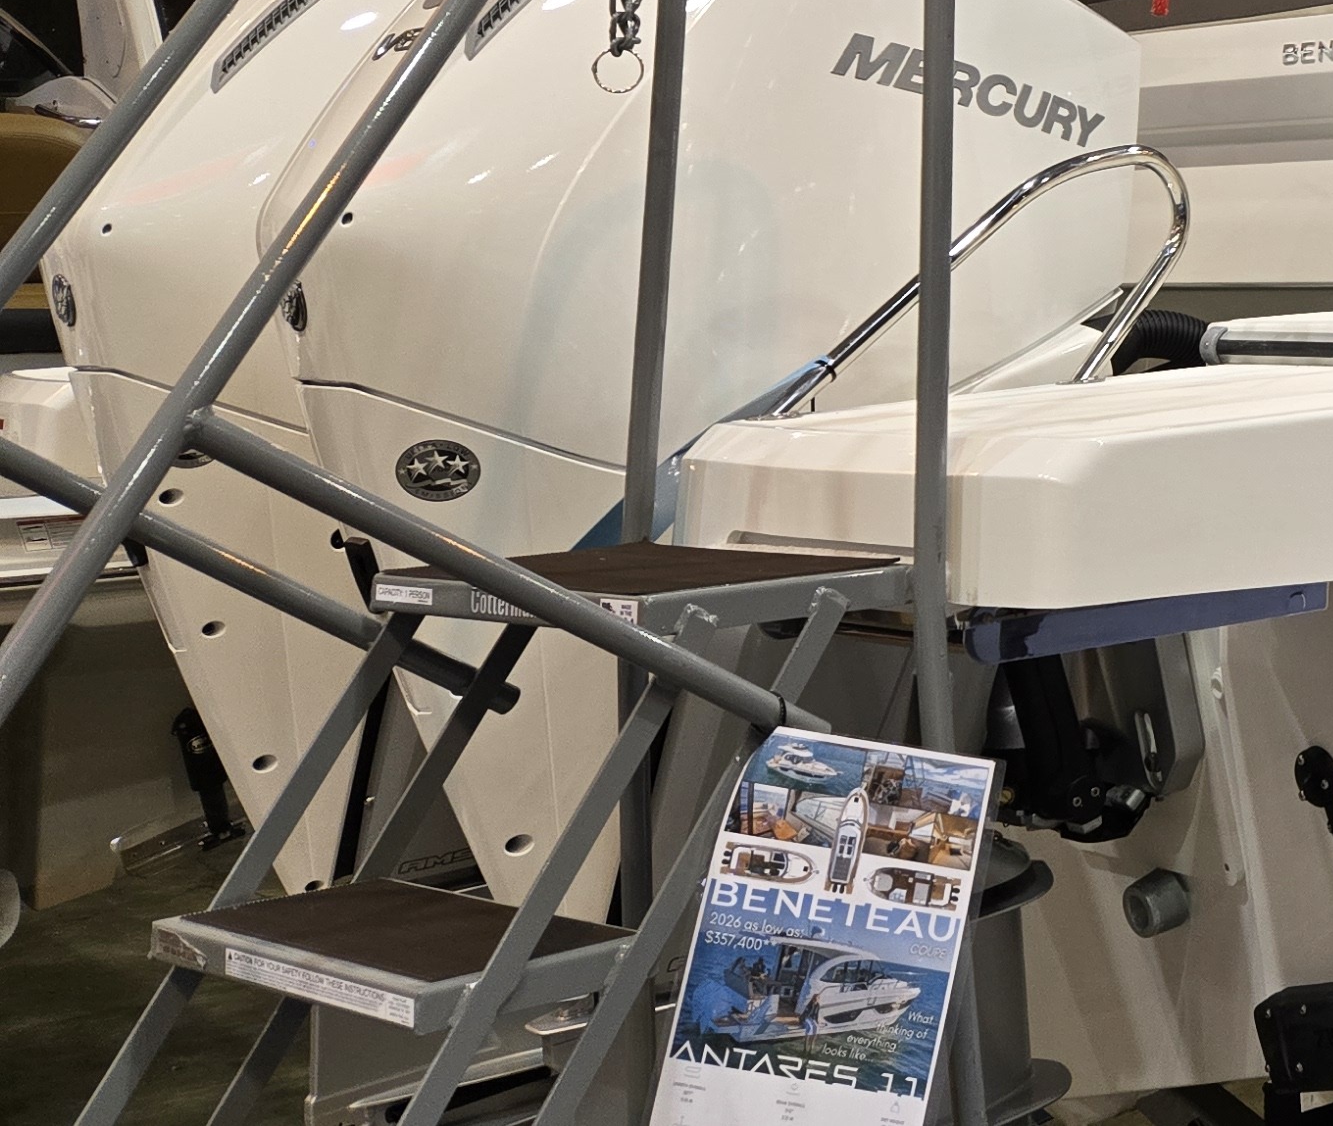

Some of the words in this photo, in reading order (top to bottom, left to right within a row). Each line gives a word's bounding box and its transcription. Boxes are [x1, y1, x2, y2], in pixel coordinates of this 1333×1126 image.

[830, 32, 1106, 148] MERCURY
[470, 586, 538, 618] Cotterm
[709, 911, 741, 929] 2026
[743, 920, 758, 933] as
[762, 921, 783, 934] low
[710, 879, 957, 943] BENETEAU
[907, 1011, 934, 1025] What
[846, 1034, 897, 1053] everything
[916, 1029, 930, 1040] of
[821, 1042, 847, 1057] looks
[669, 1039, 861, 1090] ANTARES
[876, 1072, 926, 1100] 11
